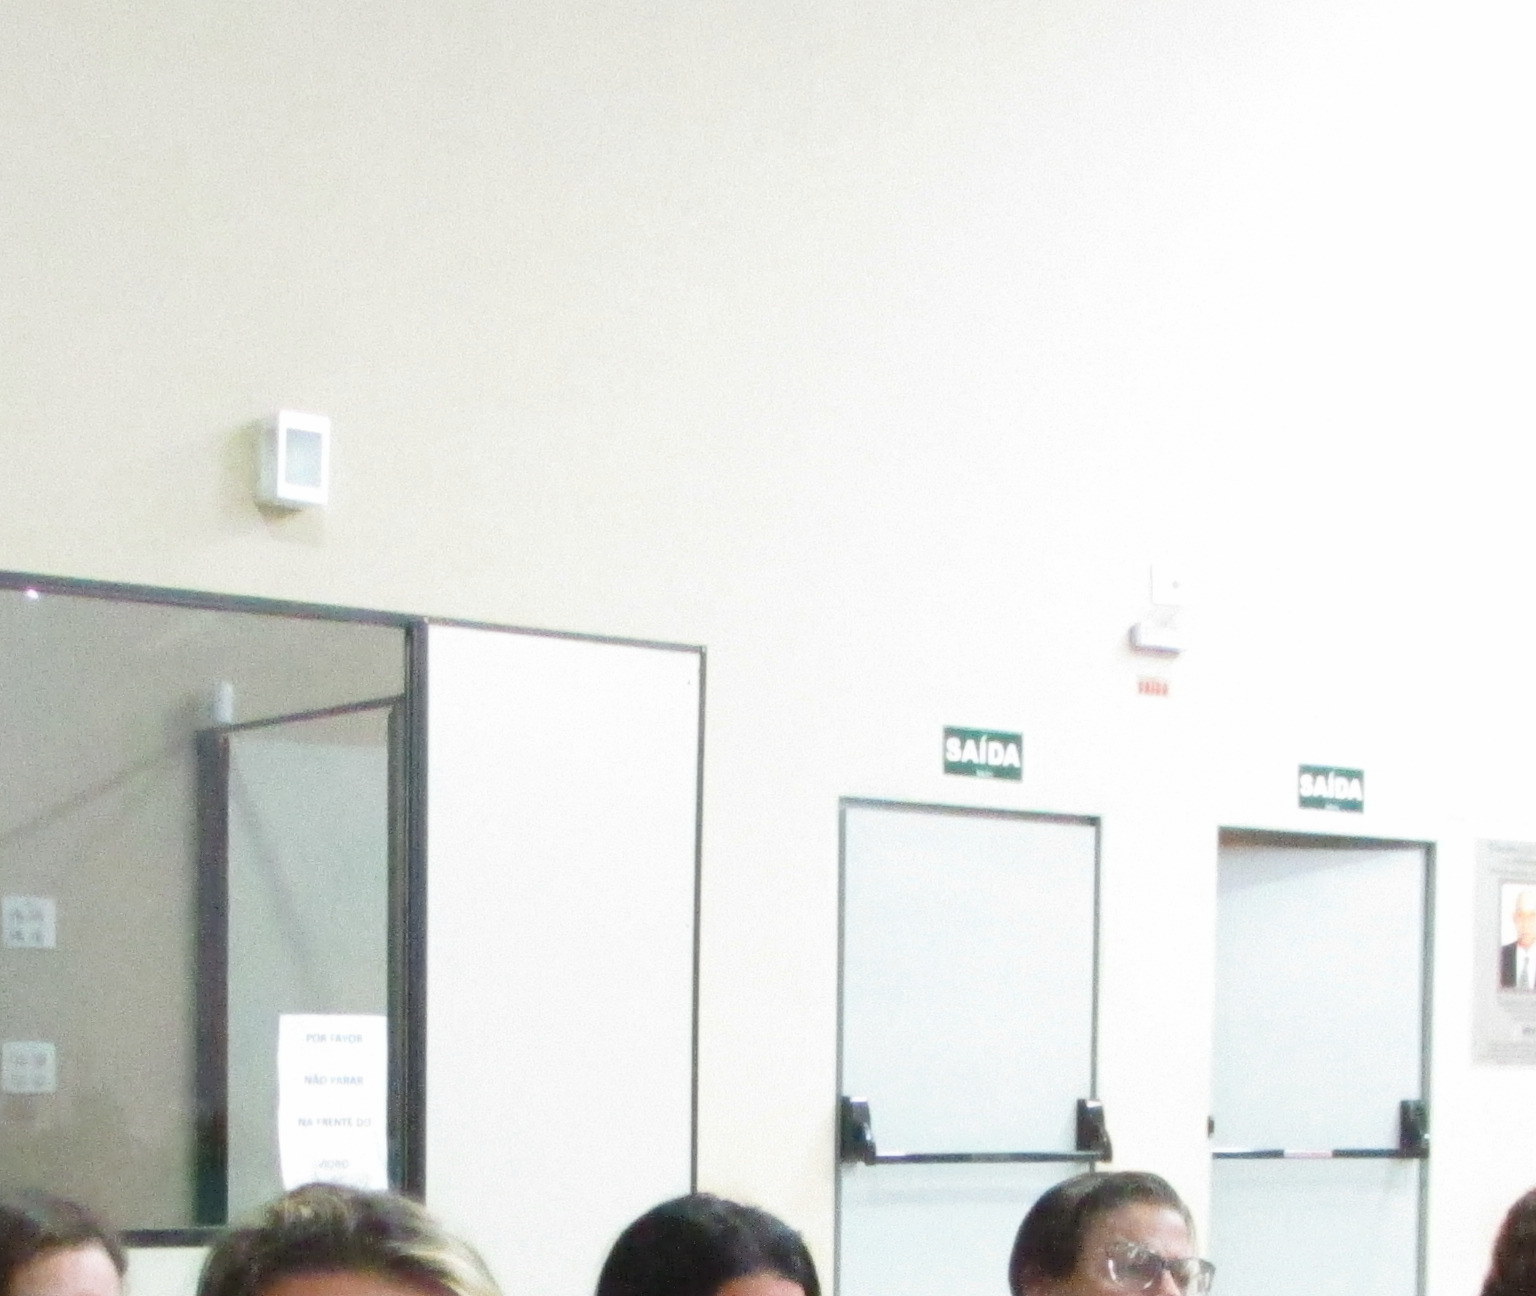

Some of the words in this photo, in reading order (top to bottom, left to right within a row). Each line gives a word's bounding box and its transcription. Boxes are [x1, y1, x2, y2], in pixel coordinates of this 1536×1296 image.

[946, 734, 1021, 768] SAÍDA
[1299, 771, 1363, 800] SAÍDA
[306, 1033, 327, 1043] POR
